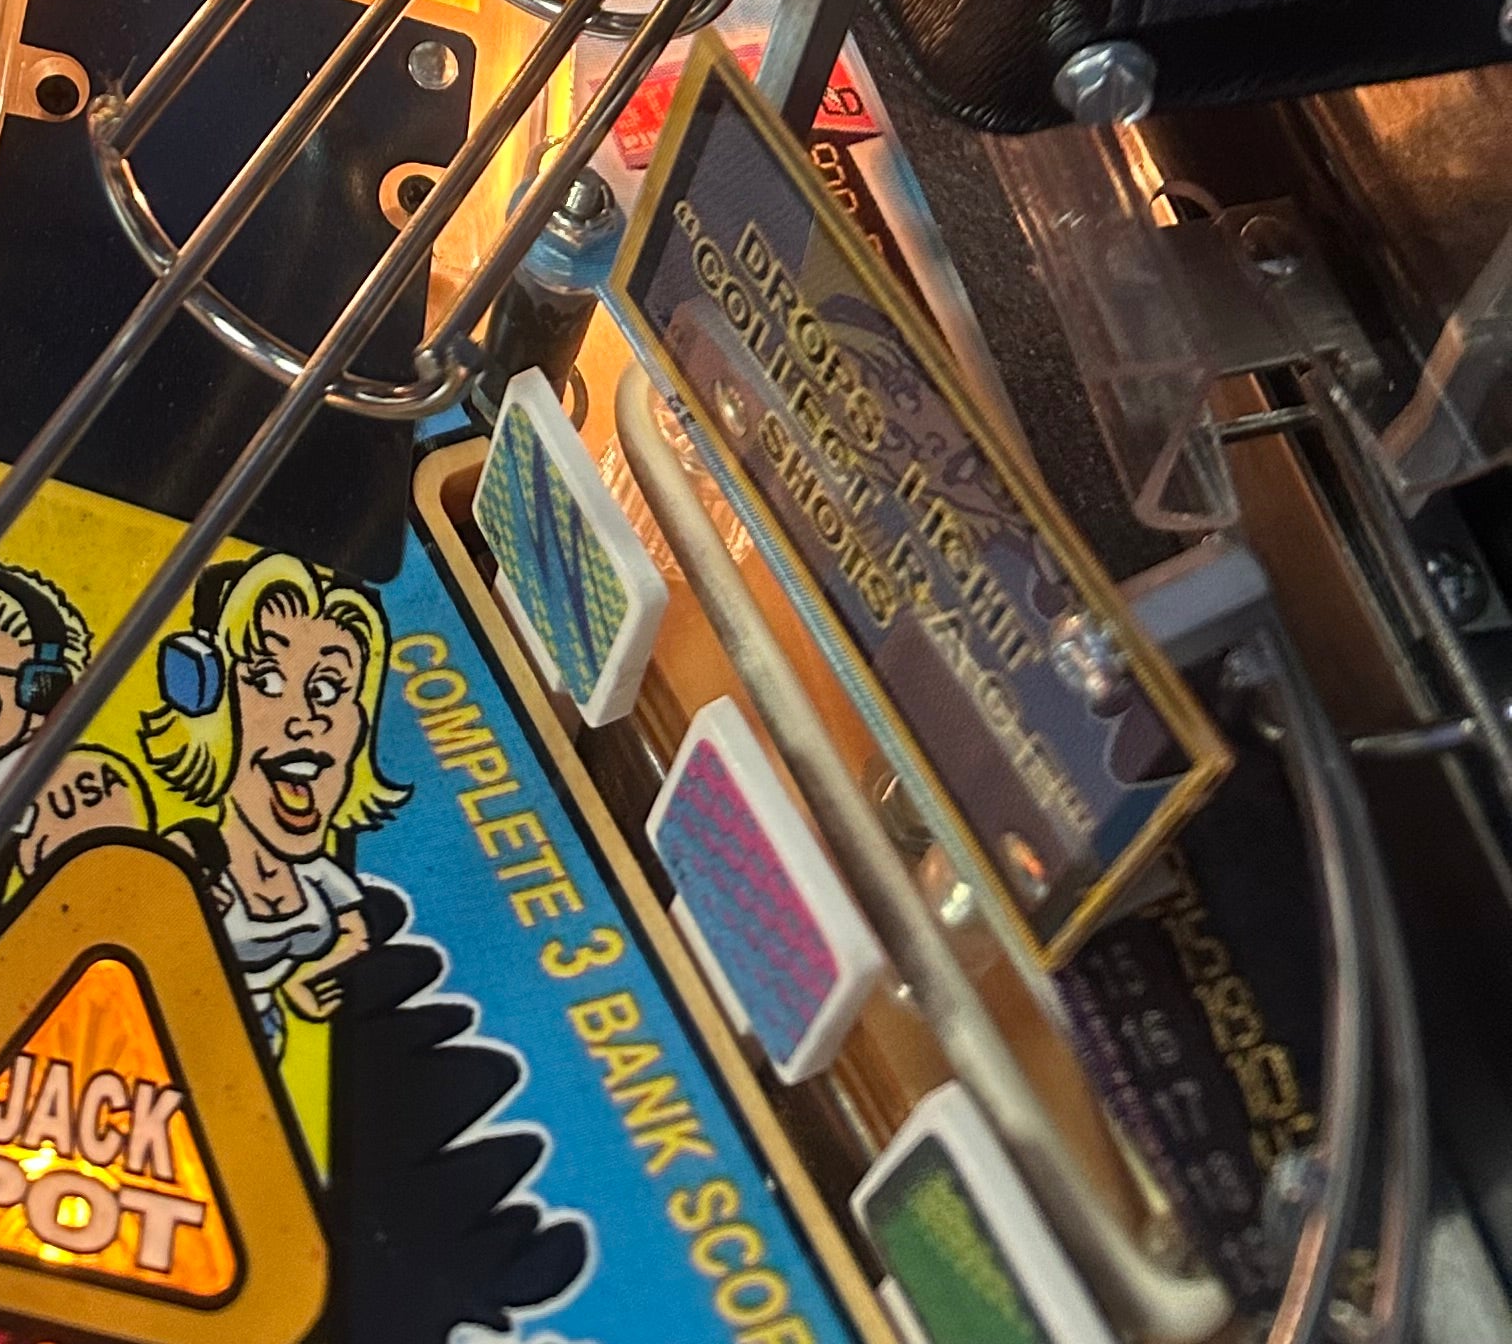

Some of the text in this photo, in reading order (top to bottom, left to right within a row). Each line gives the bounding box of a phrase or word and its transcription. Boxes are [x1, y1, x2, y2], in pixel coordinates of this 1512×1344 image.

[733, 218, 887, 452] DROPS
[756, 410, 897, 630] SHOTS
[47, 761, 129, 820] USA
[388, 630, 585, 929] COMPLETE
[538, 926, 626, 982] 3
[566, 989, 717, 1175] BANK
